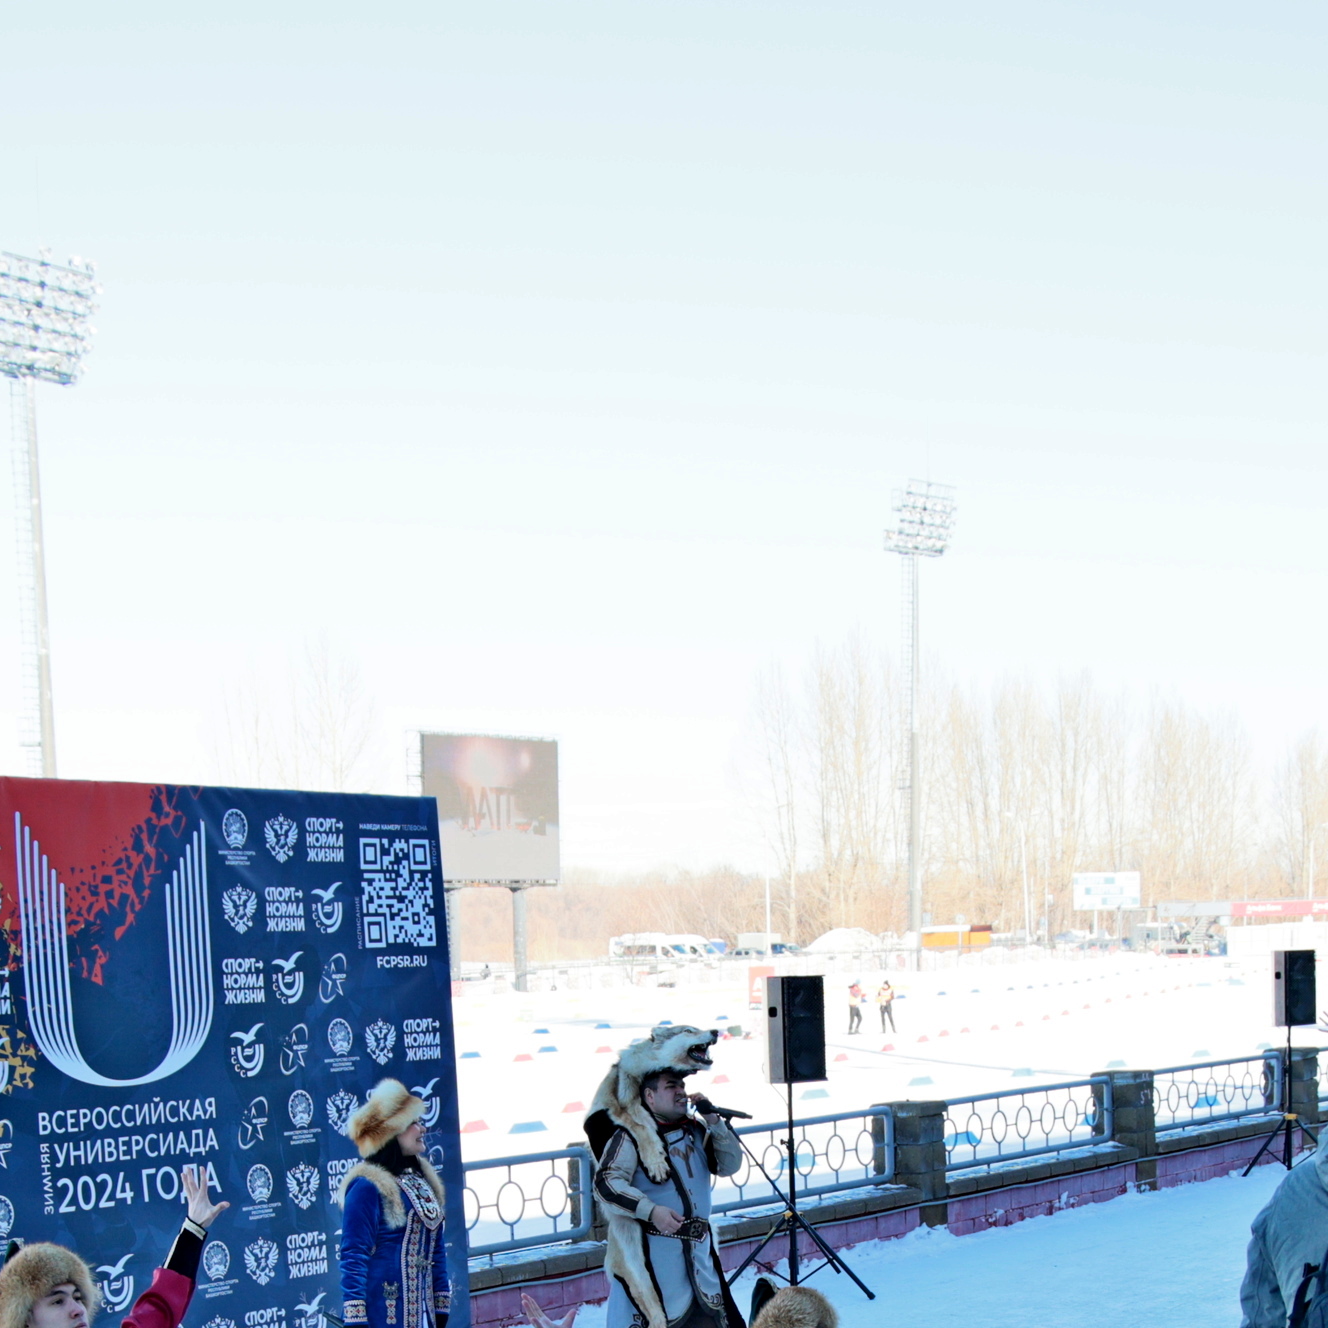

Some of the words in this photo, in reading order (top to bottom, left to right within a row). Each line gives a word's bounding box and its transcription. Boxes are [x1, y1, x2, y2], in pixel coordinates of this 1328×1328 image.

[305, 817, 336, 832] СПОРТ
[306, 832, 344, 847] НОРМА
[307, 848, 344, 862] ЖИЗНИ
[264, 887, 295, 901] СПОРТ
[266, 902, 304, 916] НОРМА
[266, 917, 305, 932] ЖИЗНИ
[355, 896, 363, 950] РАСПИСАНИЕ
[222, 958, 255, 973] СПОРТ
[377, 955, 428, 968] FCPSR.RU
[223, 973, 264, 988] НОРМА
[225, 988, 265, 1004] ЖИЗНИ
[403, 1018, 432, 1032] СПОРТ
[404, 1033, 440, 1047] НОРМА
[406, 1046, 441, 1062] ЖИЗНИ
[38, 1097, 217, 1135] ВСЕРОССИЙСКАЯ
[53, 1128, 219, 1168] УНИВЕРСИАДА
[40, 1143, 54, 1215] ЗИМНЯЯ
[56, 1171, 134, 1214] 2024
[286, 1232, 319, 1249] СПОРТ
[287, 1244, 327, 1264] НОРМА
[289, 1260, 328, 1279] ЖИЗНИ
[244, 1307, 278, 1325] СПОРТ
